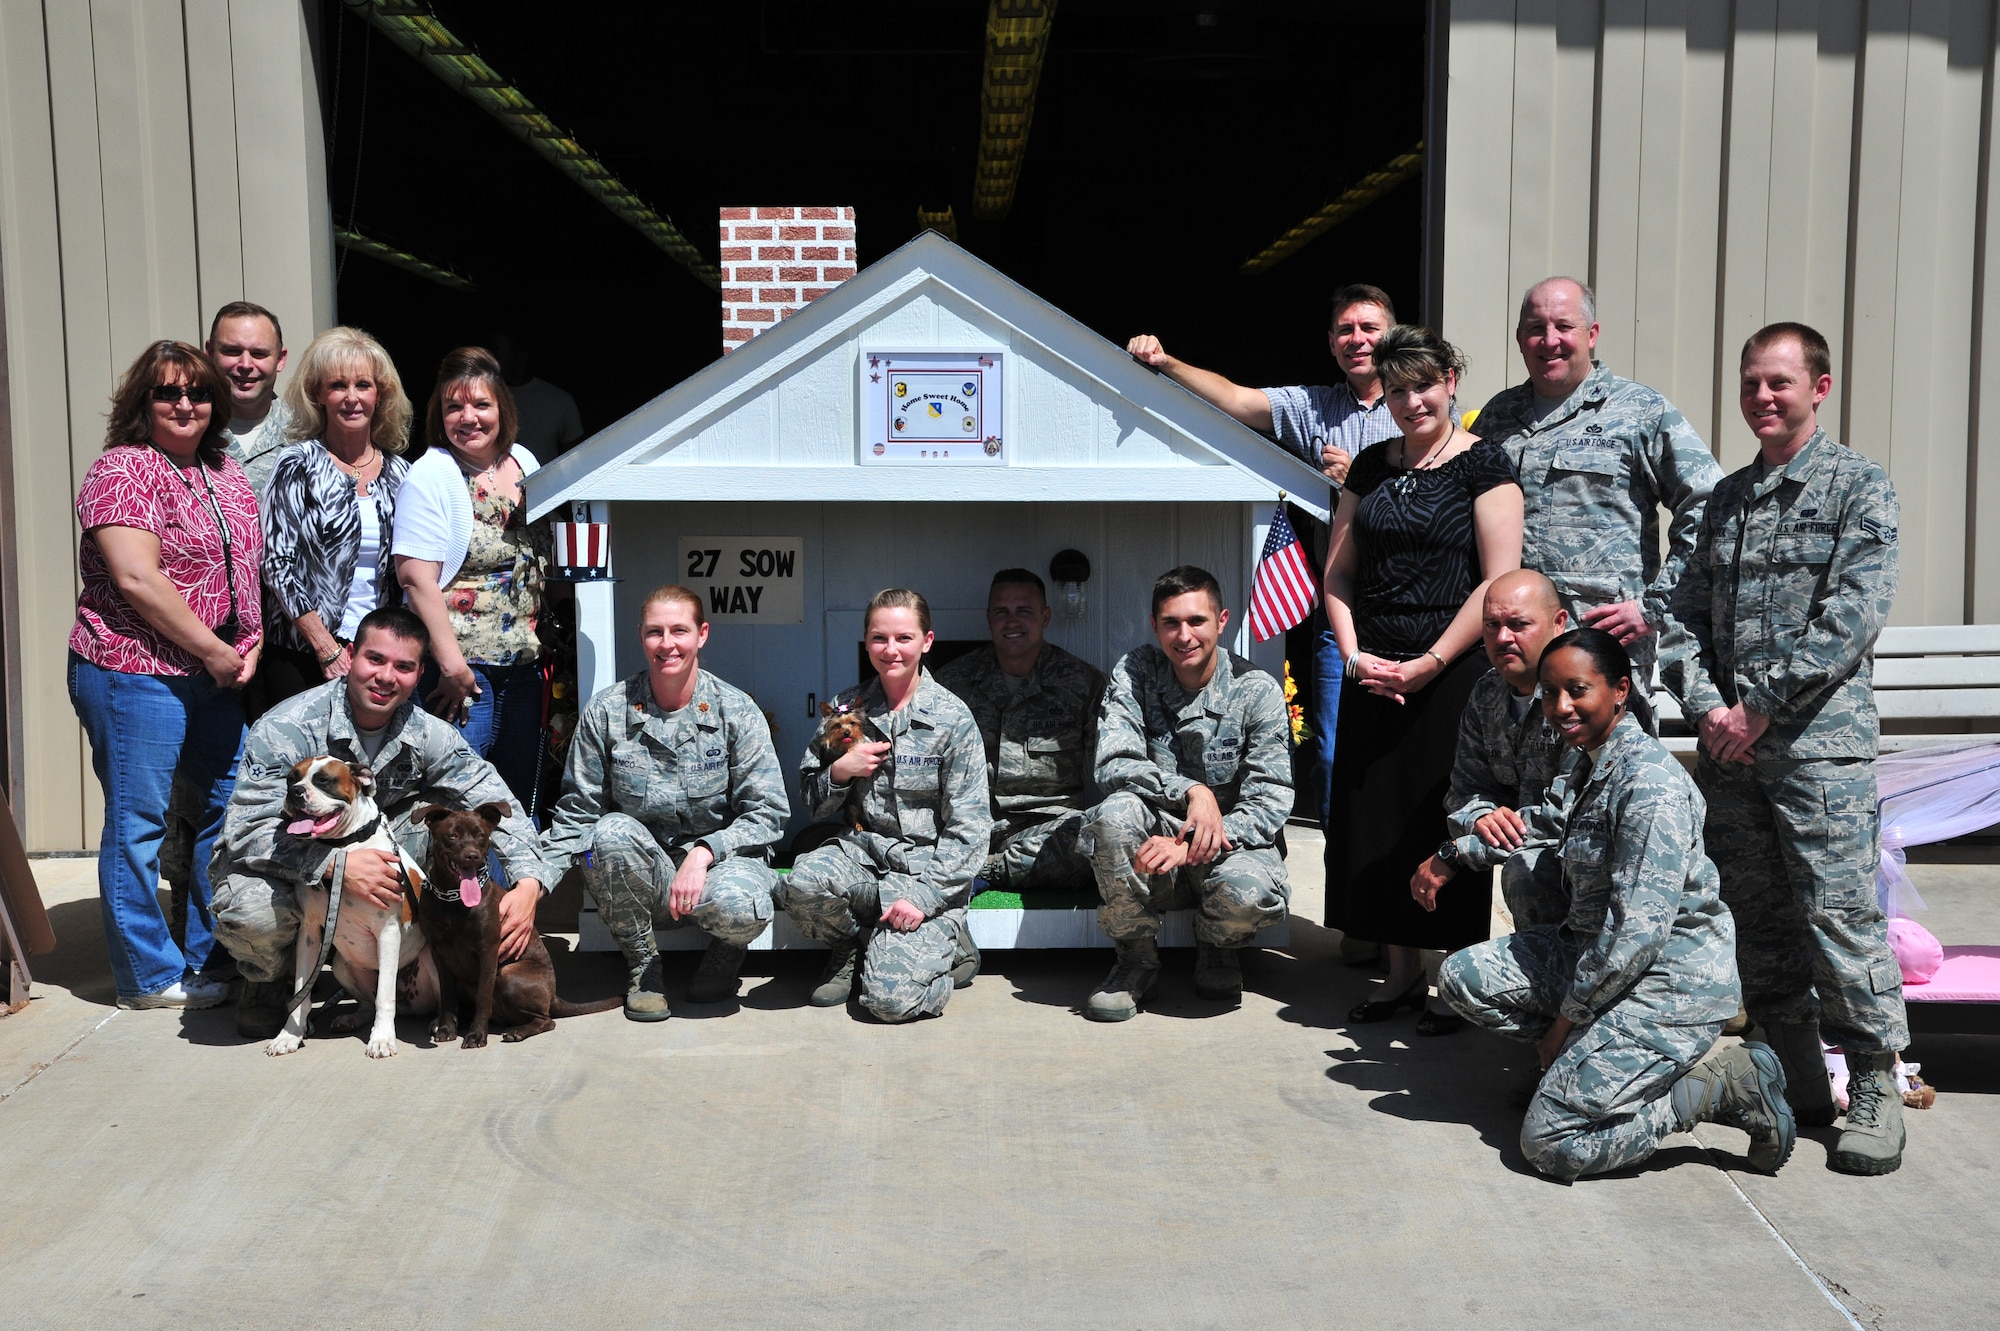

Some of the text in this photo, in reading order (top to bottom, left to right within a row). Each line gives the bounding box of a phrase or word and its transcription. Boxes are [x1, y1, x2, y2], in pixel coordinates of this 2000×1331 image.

[901, 397, 921, 412] Home
[950, 396, 969, 412] Home
[1591, 439, 1615, 449] FORCE
[1793, 523, 1807, 533] AIR
[1810, 522, 1838, 533] FORCE
[687, 549, 795, 578] 27 SOW
[709, 586, 764, 614] WAY
[908, 756, 921, 766] AIR
[1221, 752, 1234, 761] AIR
[703, 761, 716, 771] AIR
